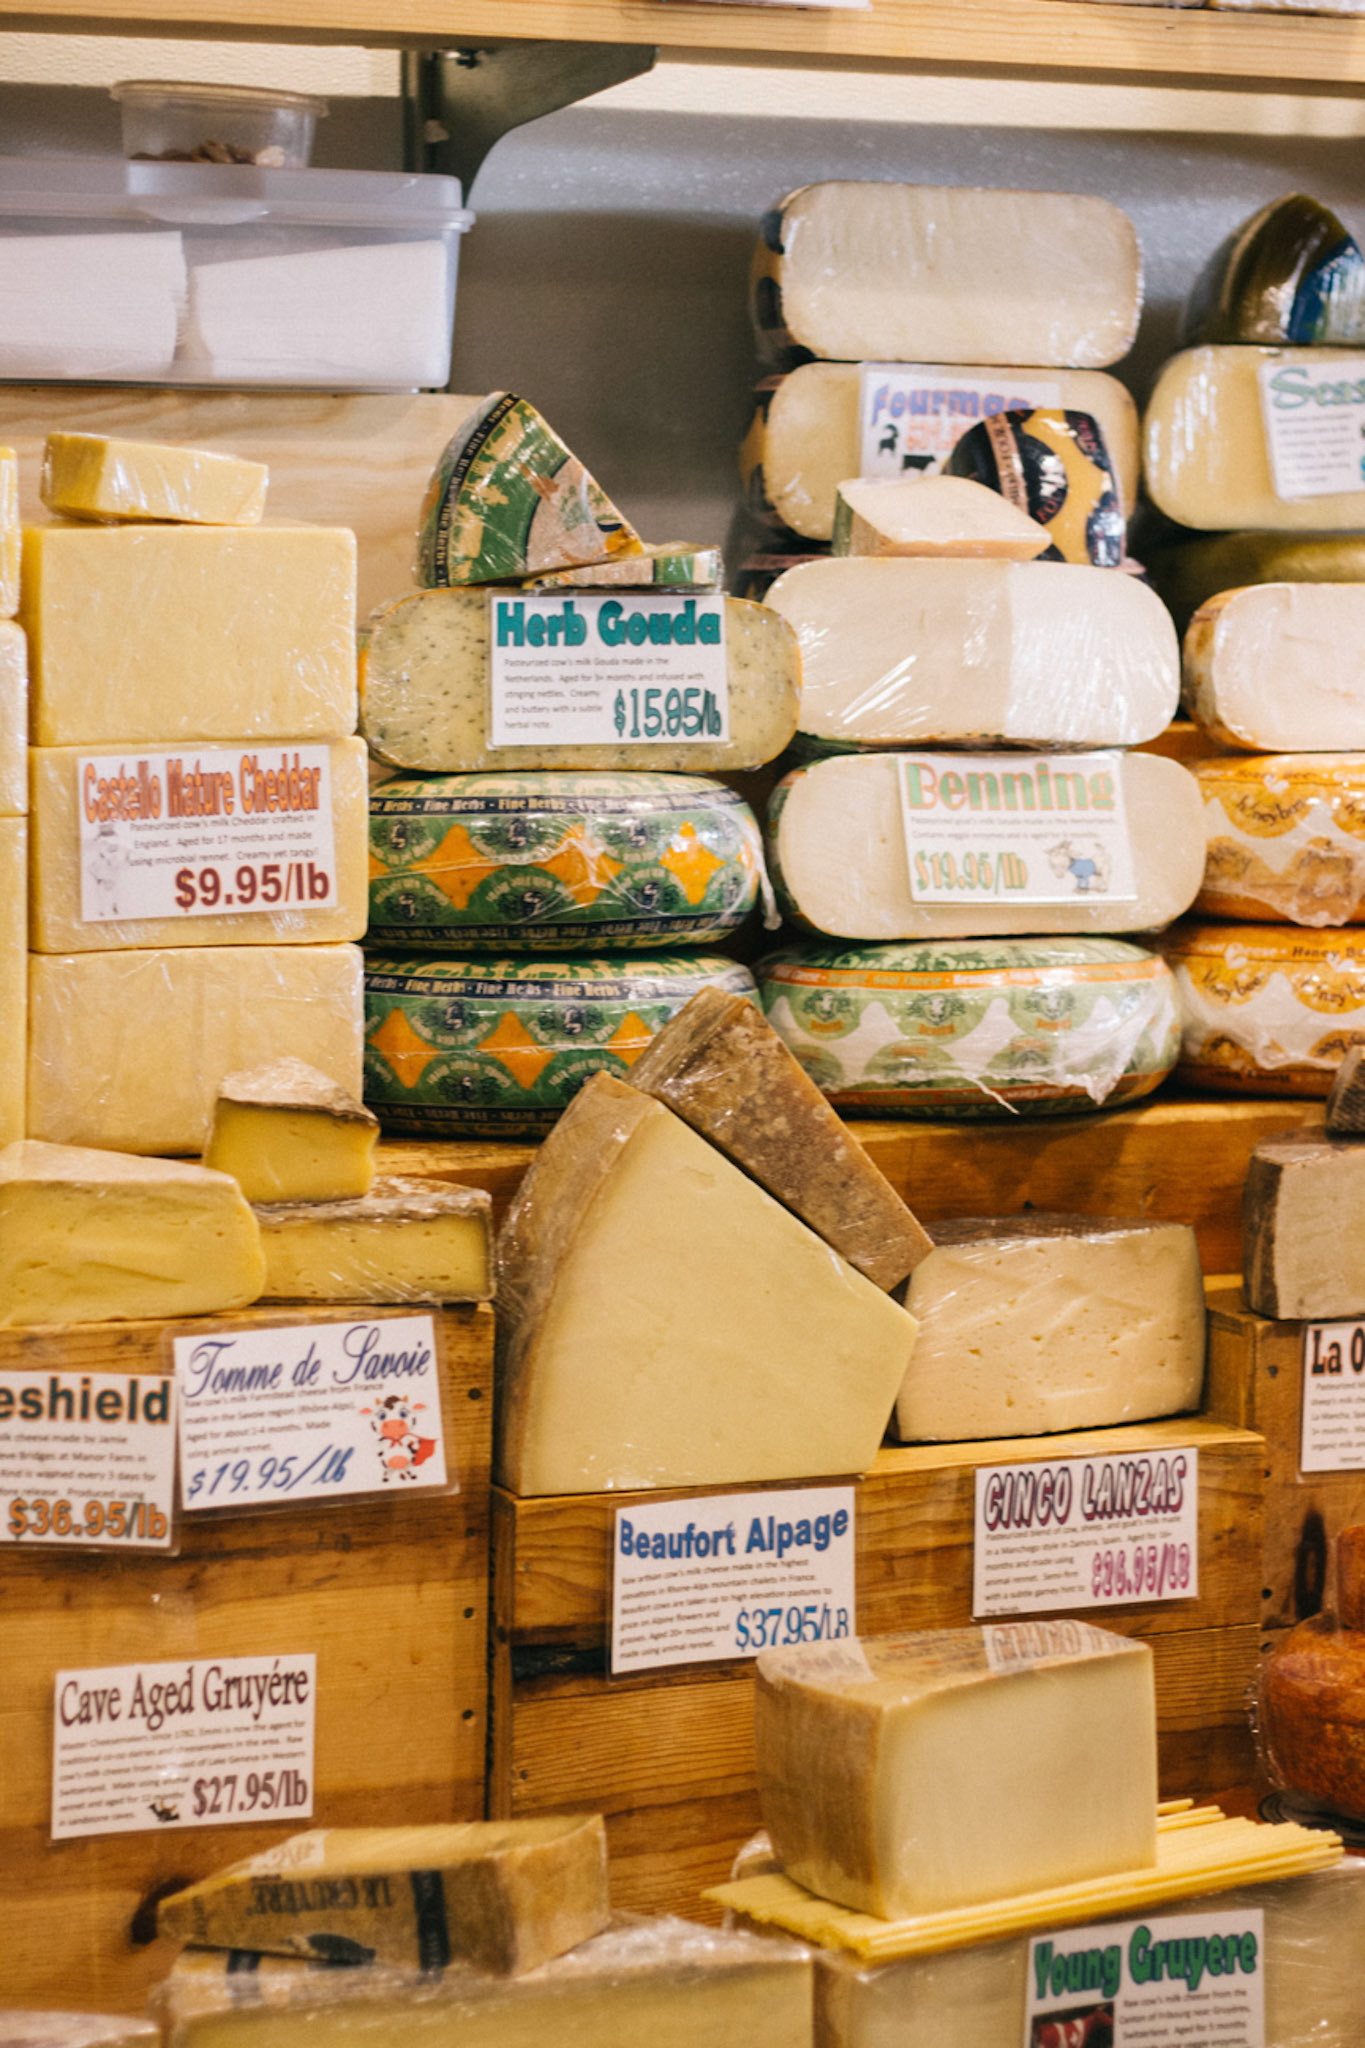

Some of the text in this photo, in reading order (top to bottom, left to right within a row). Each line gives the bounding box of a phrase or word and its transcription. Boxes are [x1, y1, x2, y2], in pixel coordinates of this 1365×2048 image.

[872, 384, 1042, 426] Fourma
[497, 600, 721, 647] Herb Gouda
[83, 753, 321, 823] Castello Mature Cheddar
[904, 761, 1116, 811] Benning
[174, 862, 330, 913] $9.95/lb
[181, 1325, 431, 1398] Tomme de Savoie
[1311, 1329, 1343, 1376] La
[187, 1445, 356, 1500] $19.95/lb
[984, 1455, 1187, 1532] CINCO LANZAS
[8, 1497, 168, 1541] $36.95/lb
[620, 1509, 848, 1559] Beaufort Alpage
[60, 1680, 121, 1727] Cave
[128, 1665, 195, 1731] Aged
[193, 1770, 308, 1818] $27.95/lb
[1034, 1925, 1258, 2000] Young Gruyere
